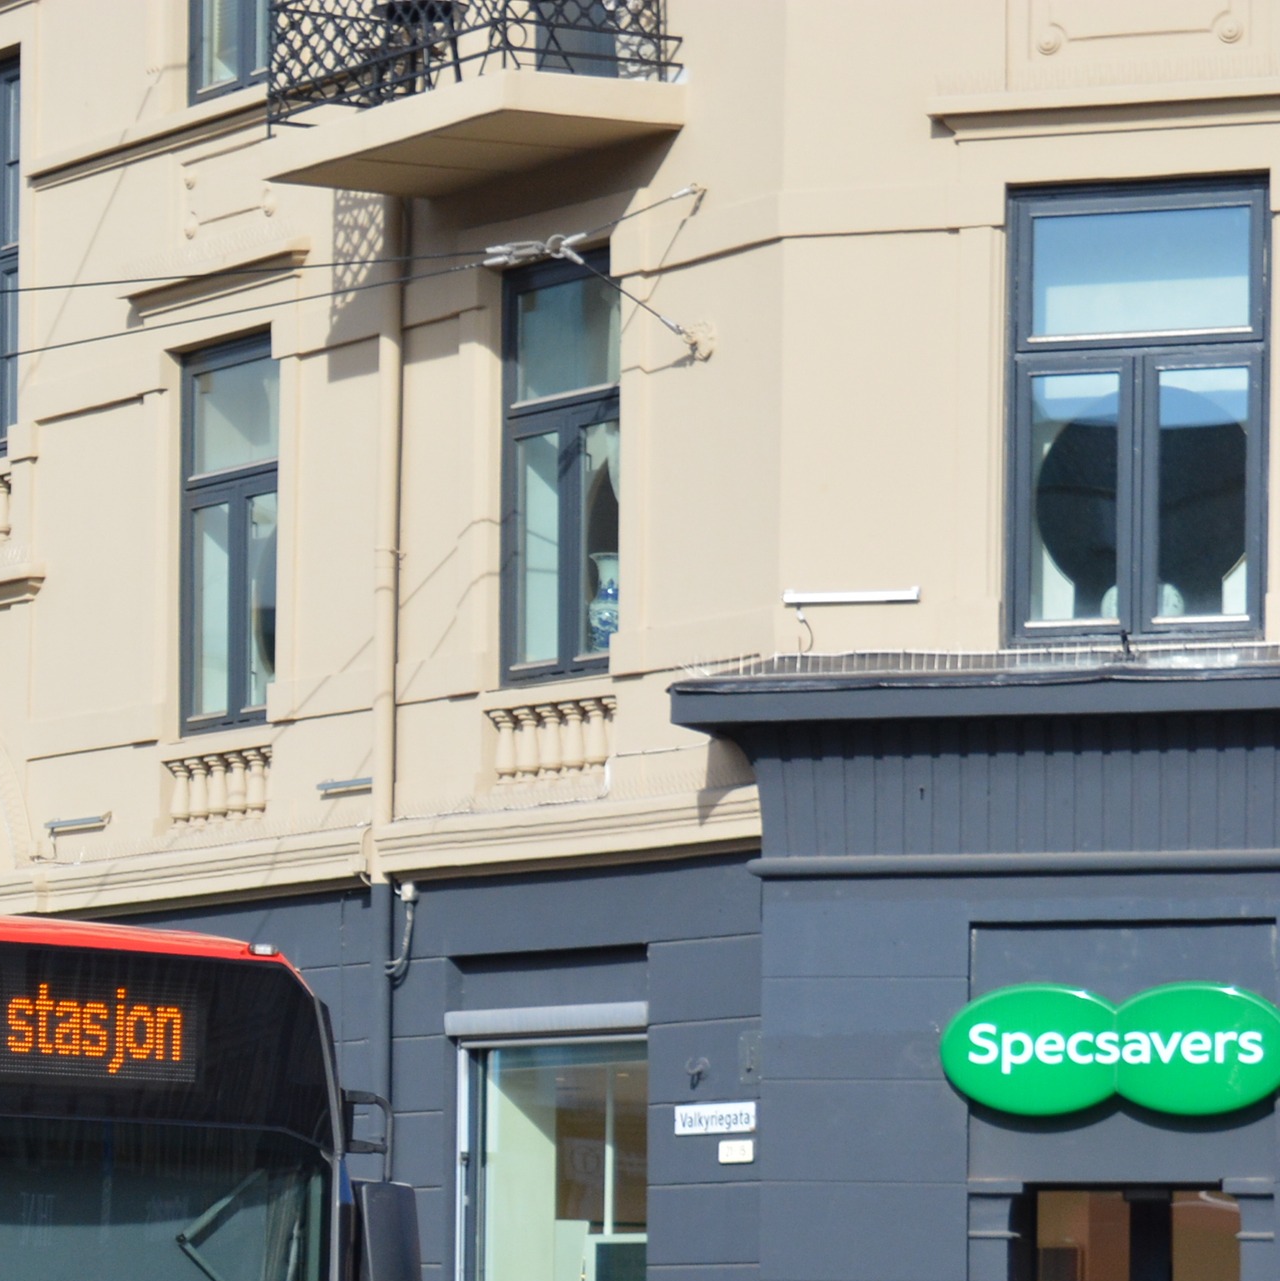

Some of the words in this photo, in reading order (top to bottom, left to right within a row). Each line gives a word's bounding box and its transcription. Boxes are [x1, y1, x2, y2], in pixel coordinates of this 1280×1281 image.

[7, 983, 183, 1074] stasjon
[967, 1023, 1265, 1075] Specsavers
[680, 1110, 751, 1131] Valkyriegata
